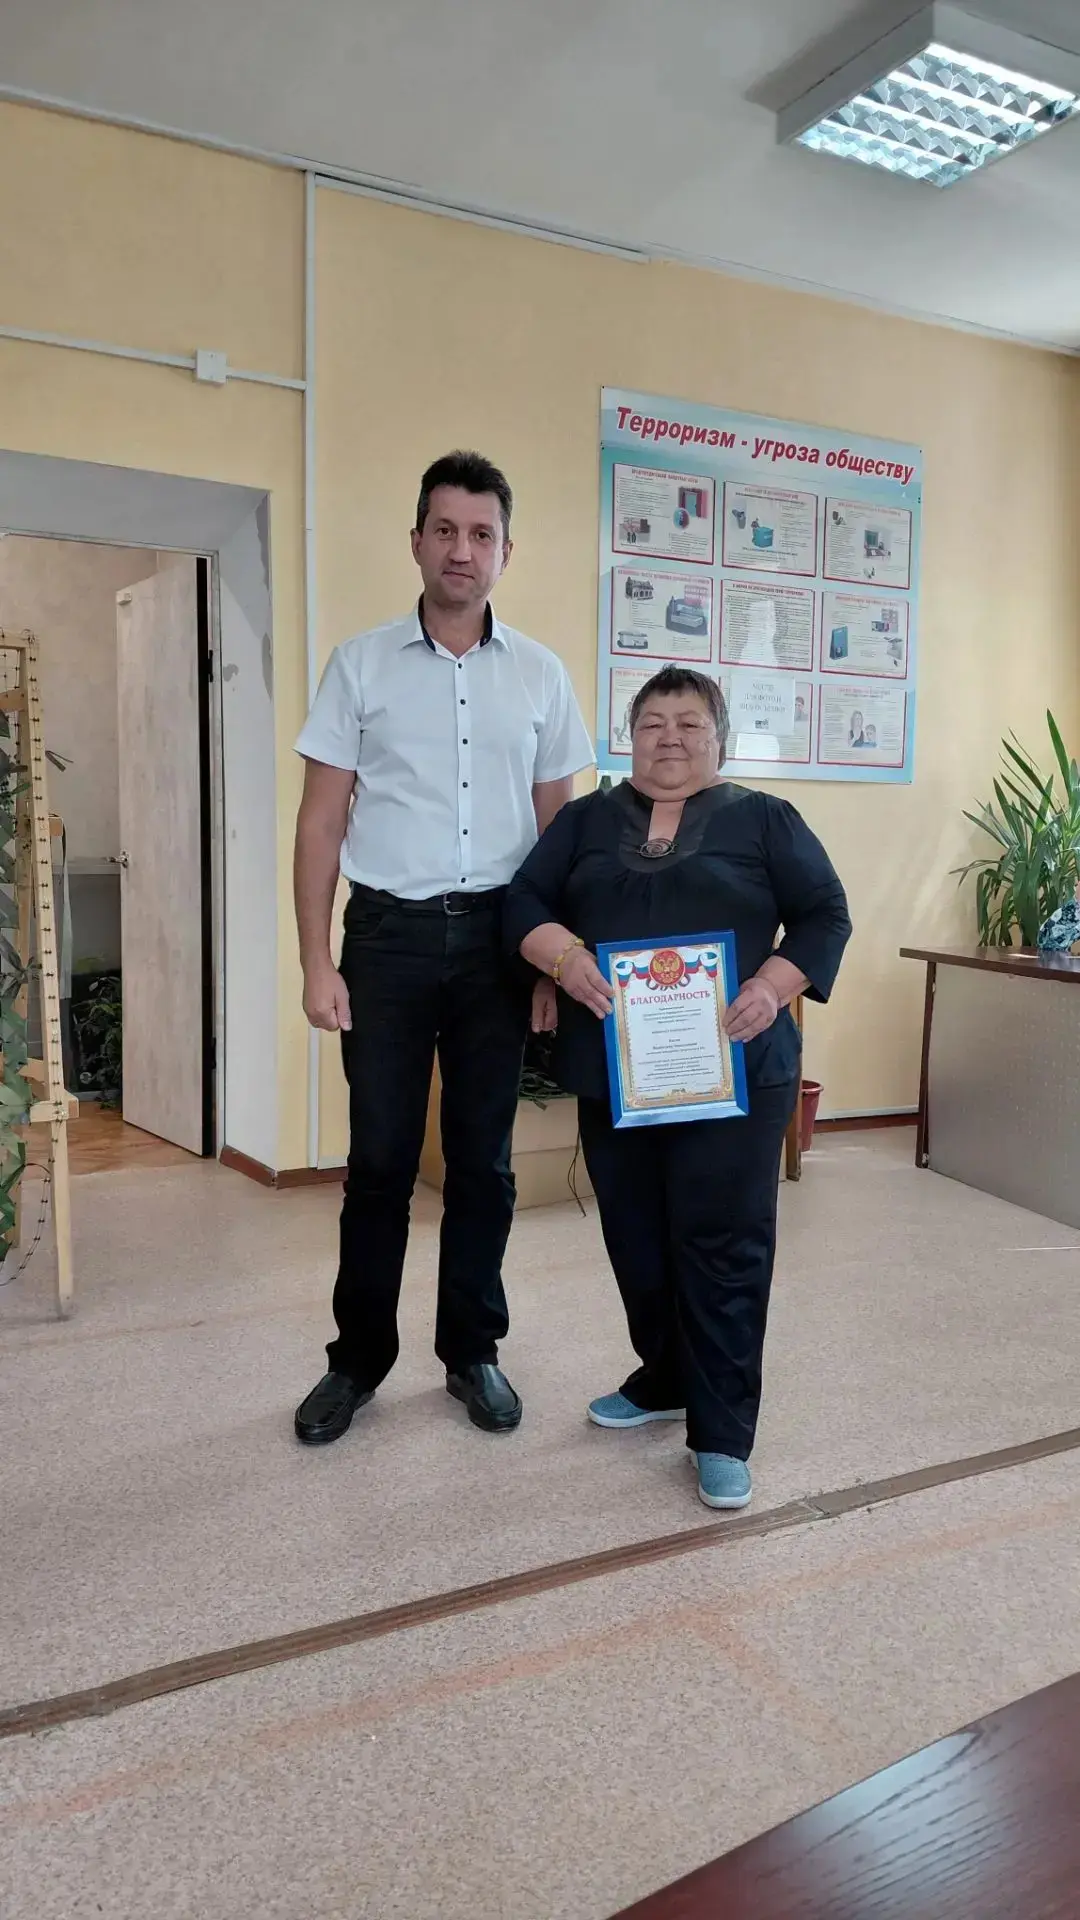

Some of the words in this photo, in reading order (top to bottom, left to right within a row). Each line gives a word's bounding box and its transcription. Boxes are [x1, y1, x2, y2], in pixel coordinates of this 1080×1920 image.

[616, 406, 736, 449] Терроризм
[751, 437, 820, 464] угроза
[825, 448, 914, 486] обществу
[630, 990, 711, 1005] БЛАГОДАРНОСТЬ
